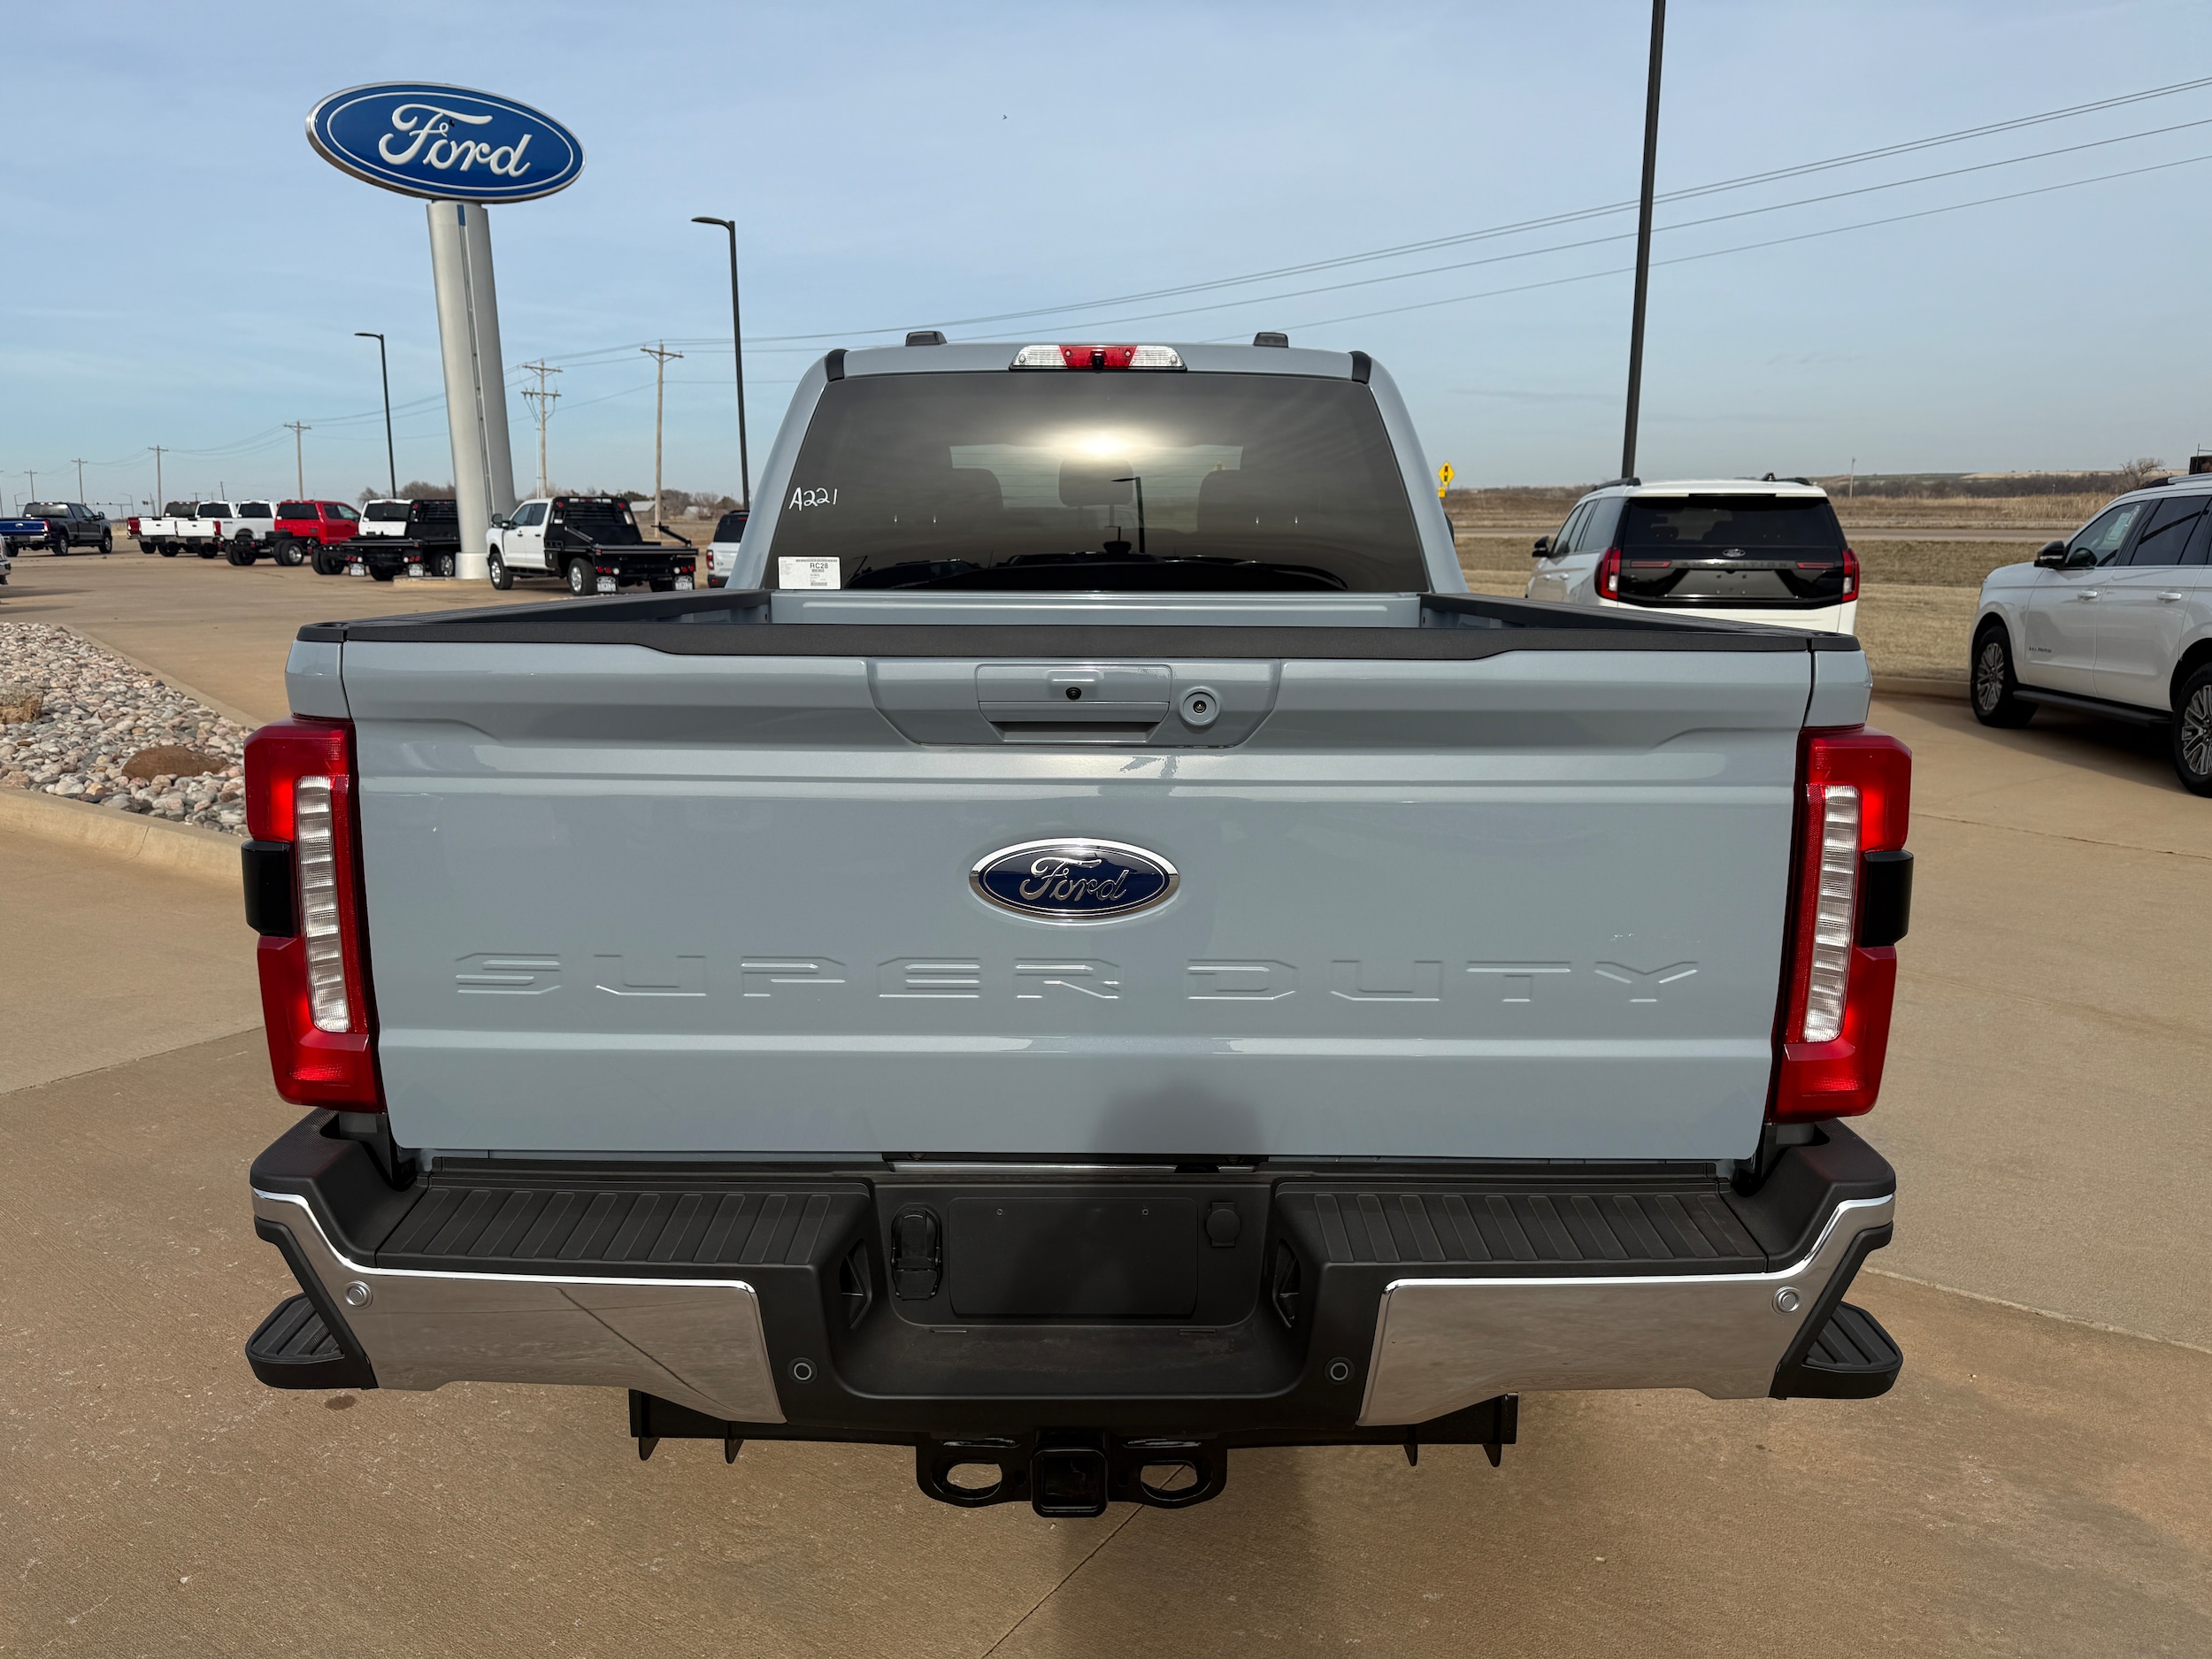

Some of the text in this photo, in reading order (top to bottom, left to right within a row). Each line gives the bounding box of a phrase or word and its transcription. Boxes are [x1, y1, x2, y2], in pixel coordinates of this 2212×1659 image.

[378, 103, 533, 177] Ford
[788, 487, 838, 511] A221
[1019, 856, 1130, 902] Ford
[455, 953, 1699, 1002] SUPER DUTY
